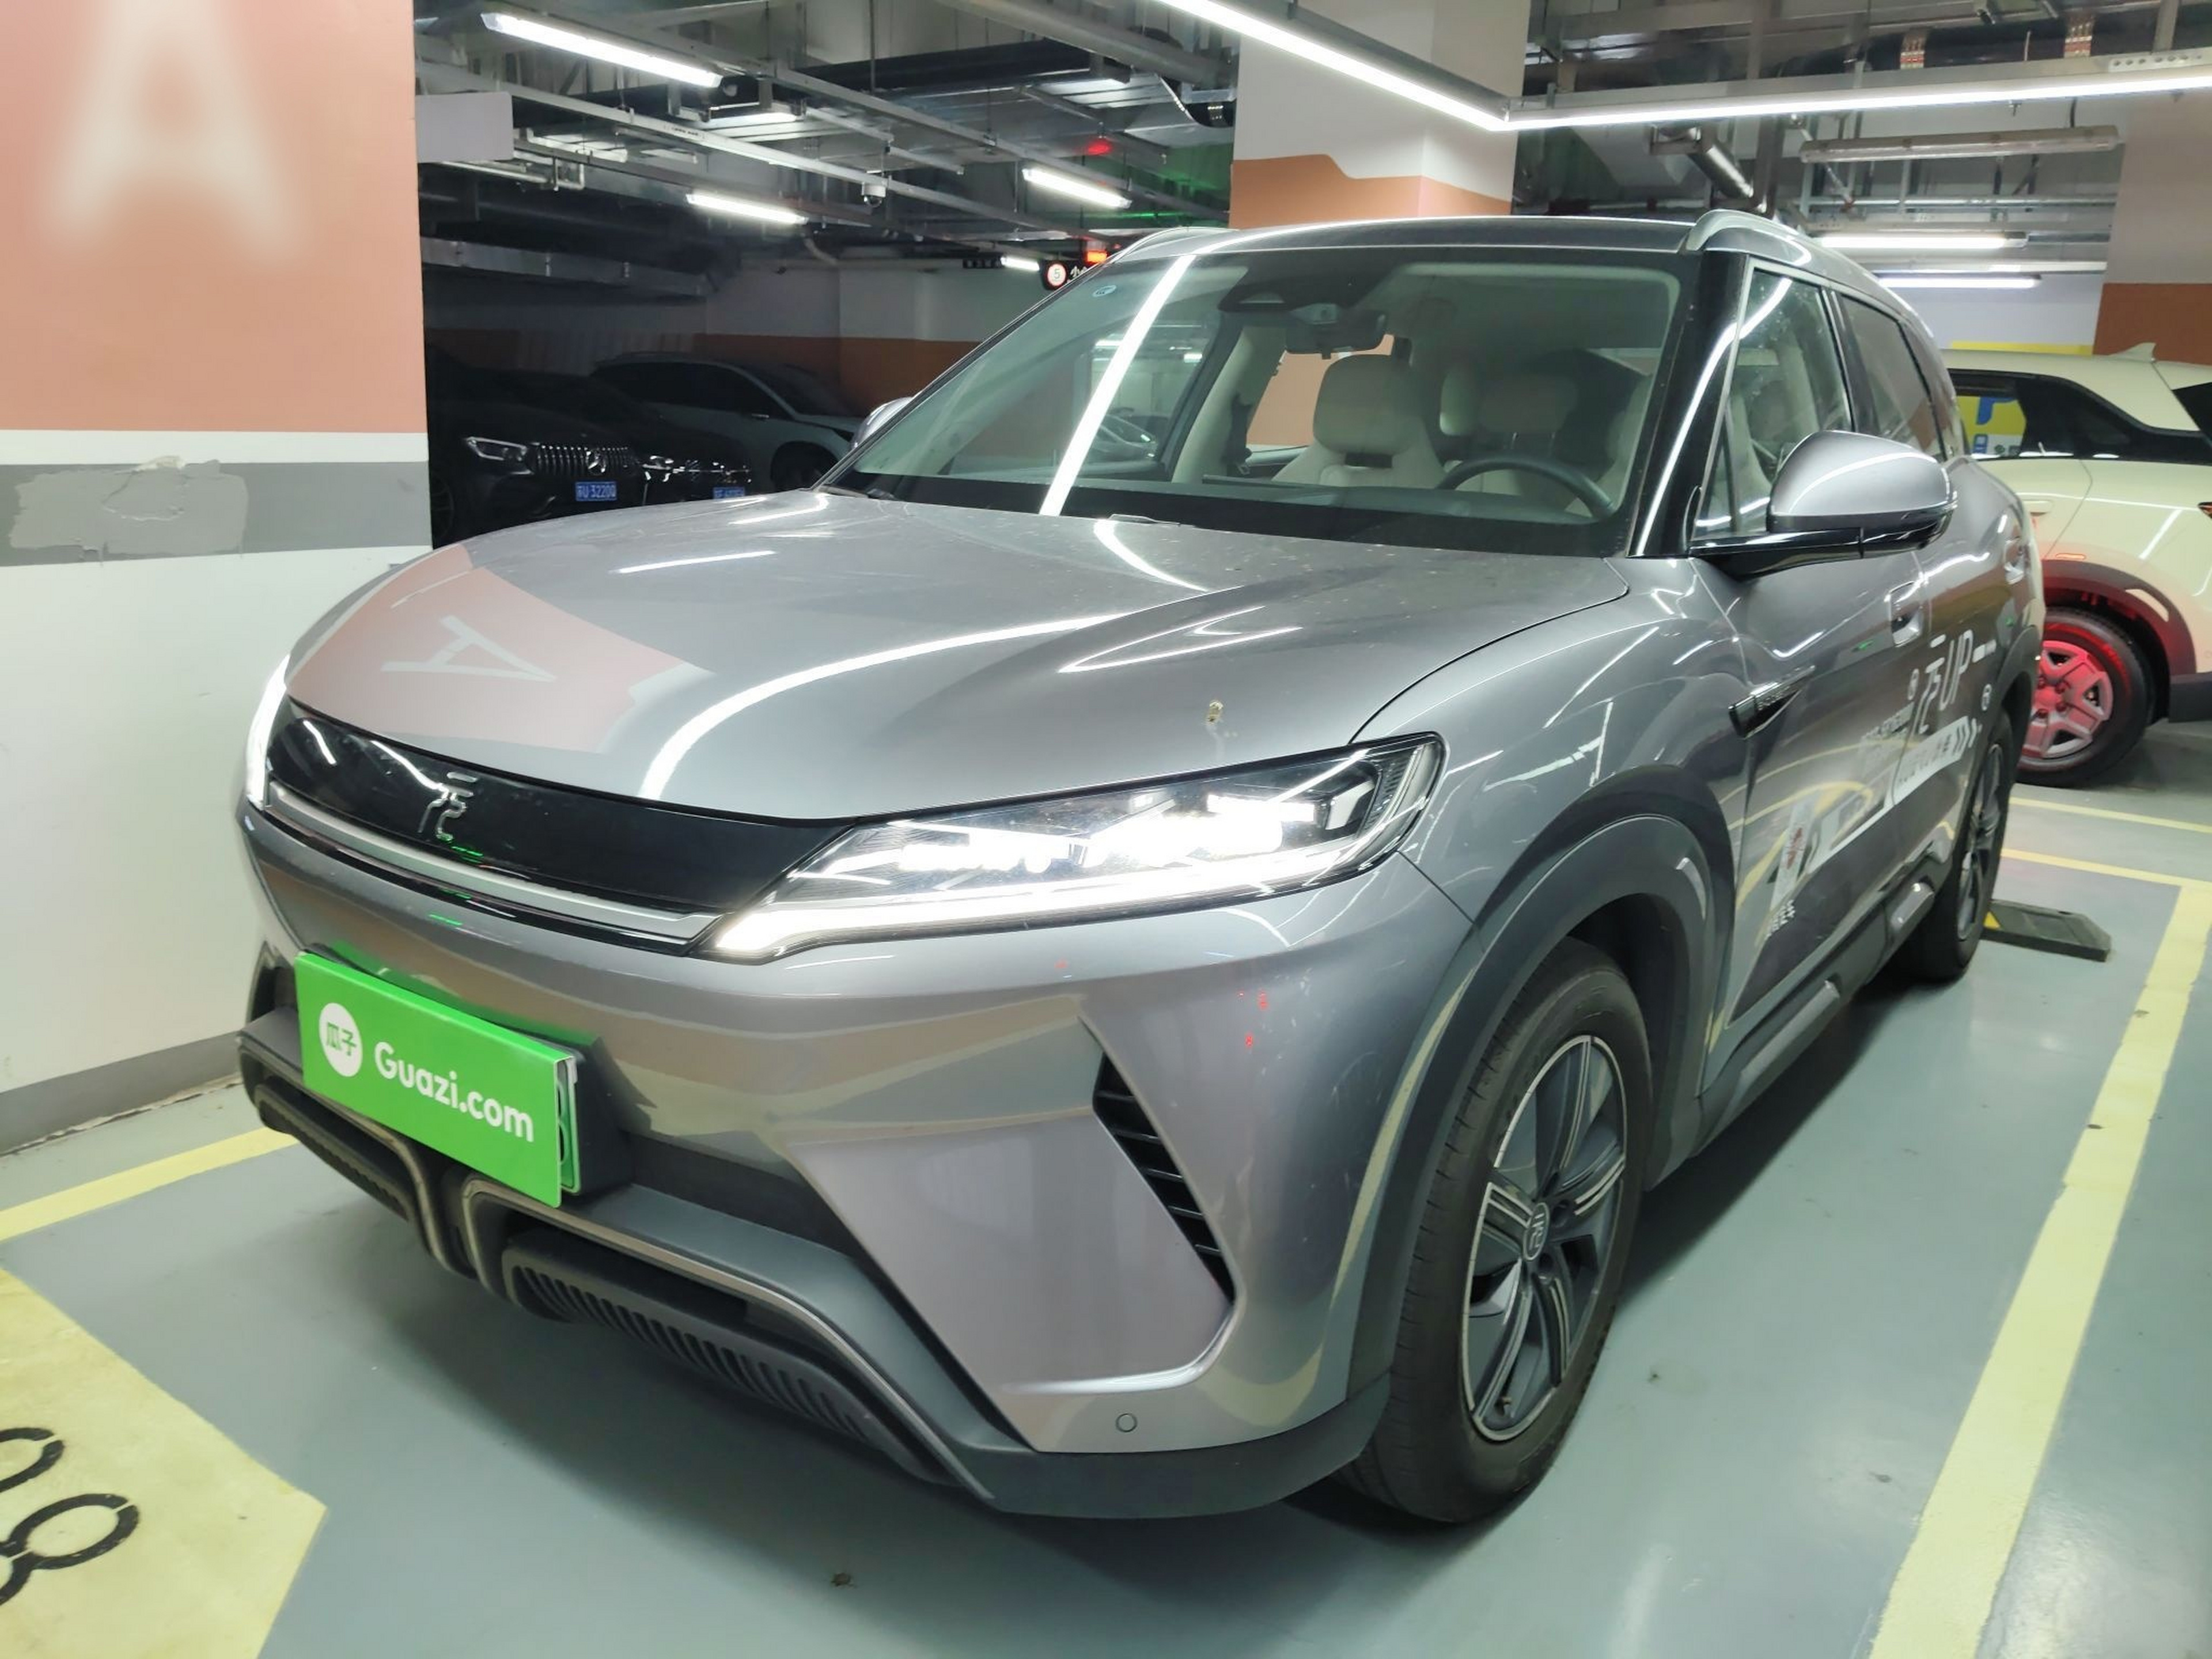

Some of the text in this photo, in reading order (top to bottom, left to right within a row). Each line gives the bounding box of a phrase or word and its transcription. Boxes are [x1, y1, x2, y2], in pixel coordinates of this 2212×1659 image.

[37, 0, 308, 266] A
[1054, 268, 1061, 279] 5
[325, 1021, 534, 1143] 瓜子 Guazi.com
